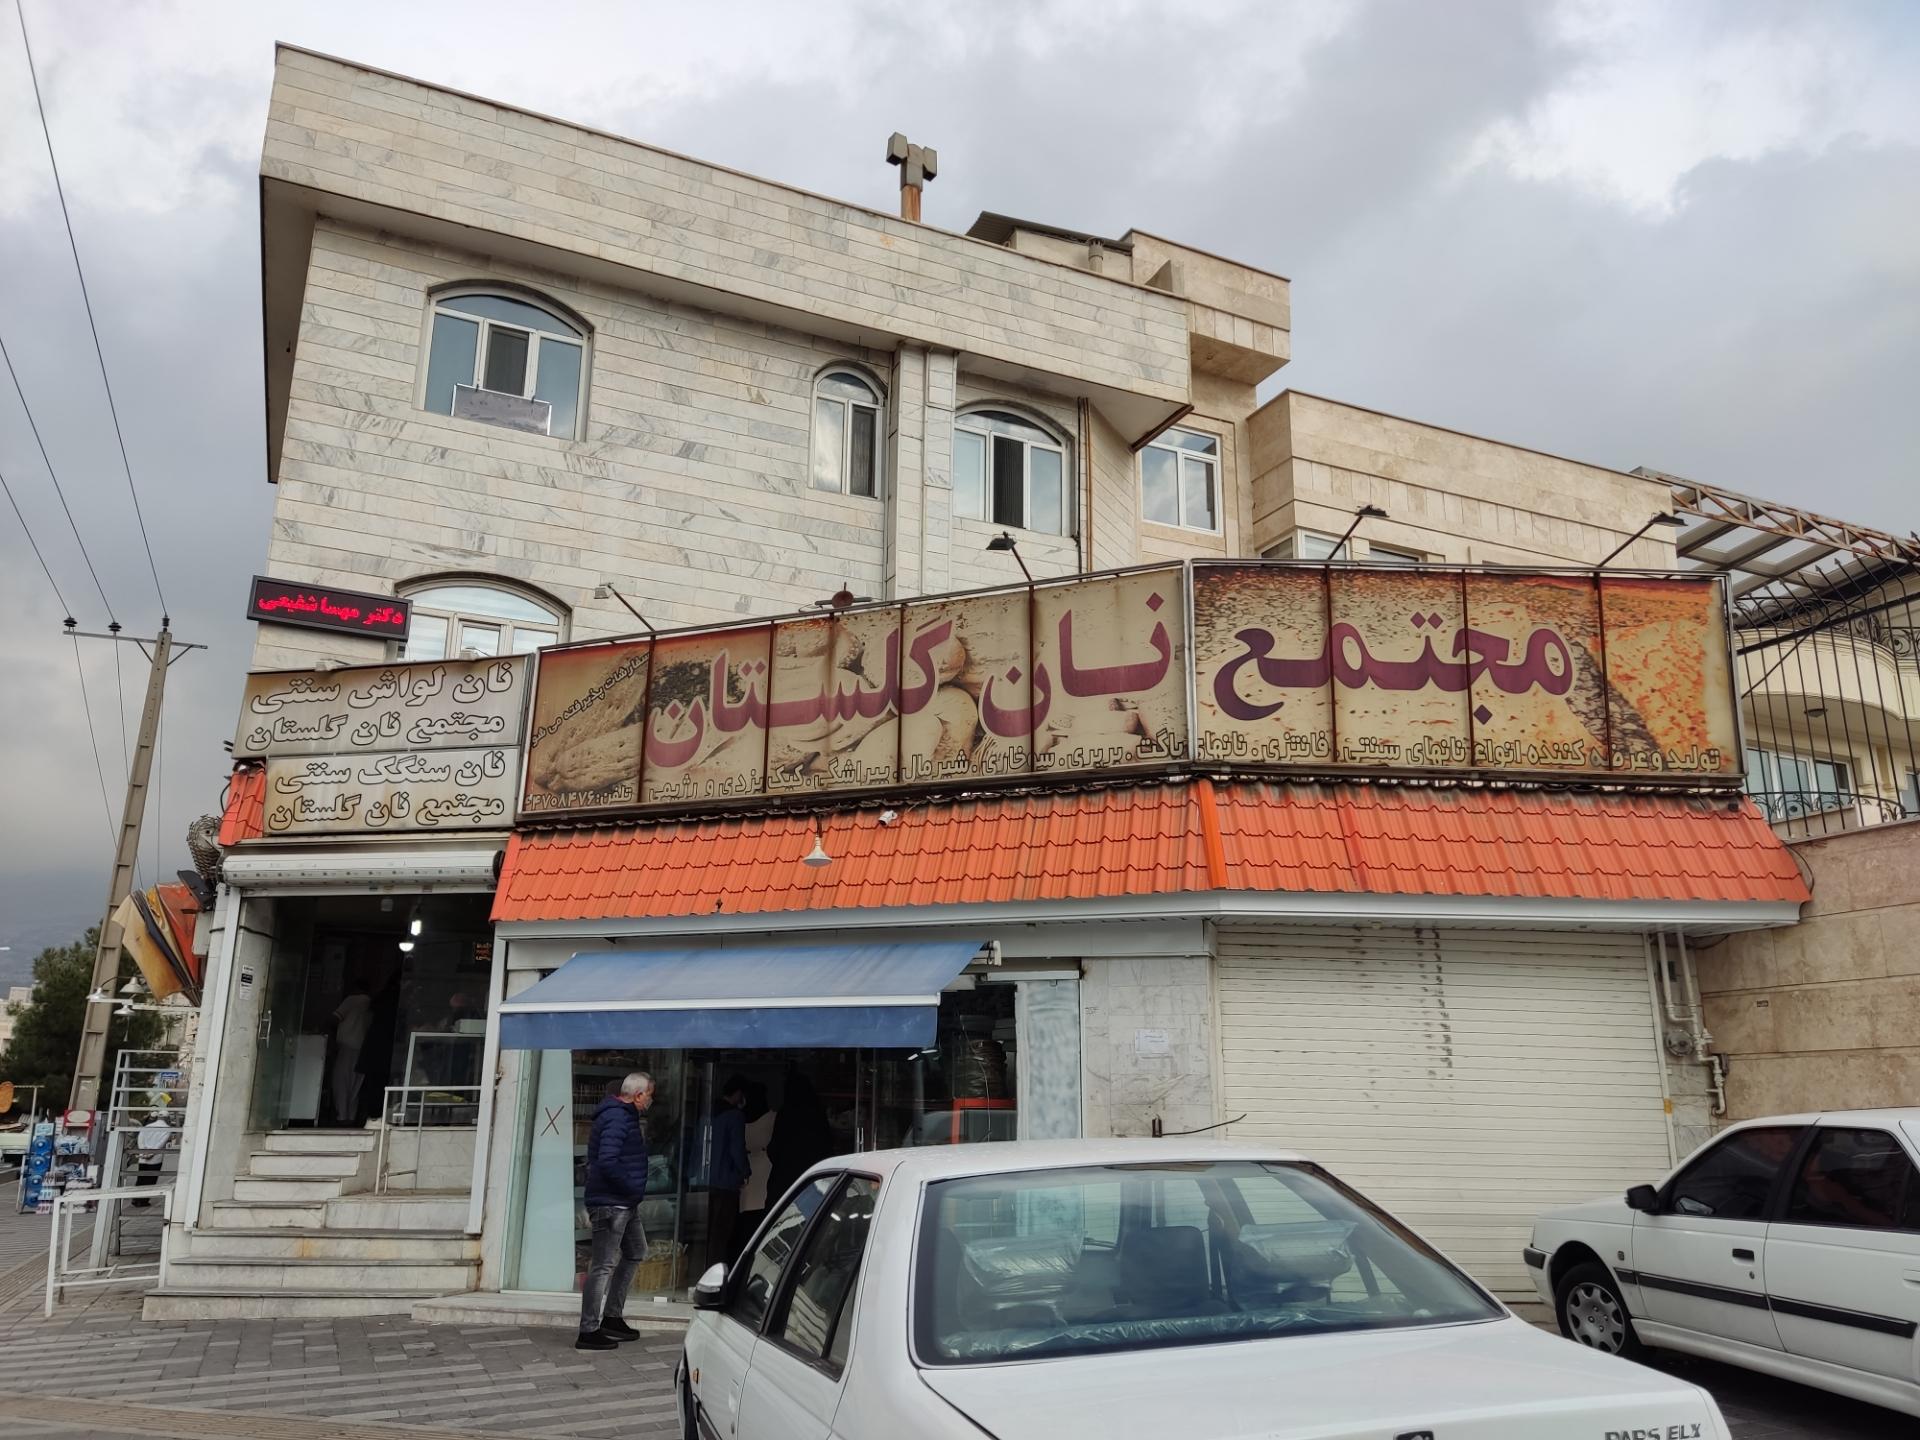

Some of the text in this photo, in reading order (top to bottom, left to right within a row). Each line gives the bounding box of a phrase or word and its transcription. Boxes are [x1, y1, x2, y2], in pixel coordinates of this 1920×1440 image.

[320, 597, 360, 620] مهسا
[362, 606, 404, 625] دکتر
[645, 592, 1171, 767] نان گلستان
[1214, 611, 1573, 725] مجتمع
[250, 662, 513, 714] نان لواش سنتی
[245, 711, 505, 752] مجتمع نان گلستان
[1475, 739, 1521, 767] انواع
[1527, 739, 1585, 766] کننده
[1666, 745, 1721, 772] تولید
[275, 751, 506, 794] نان سنگک سنتی
[268, 791, 505, 830] مجتمع نان گلستان
[1667, 1423, 1701, 1440] ELX
